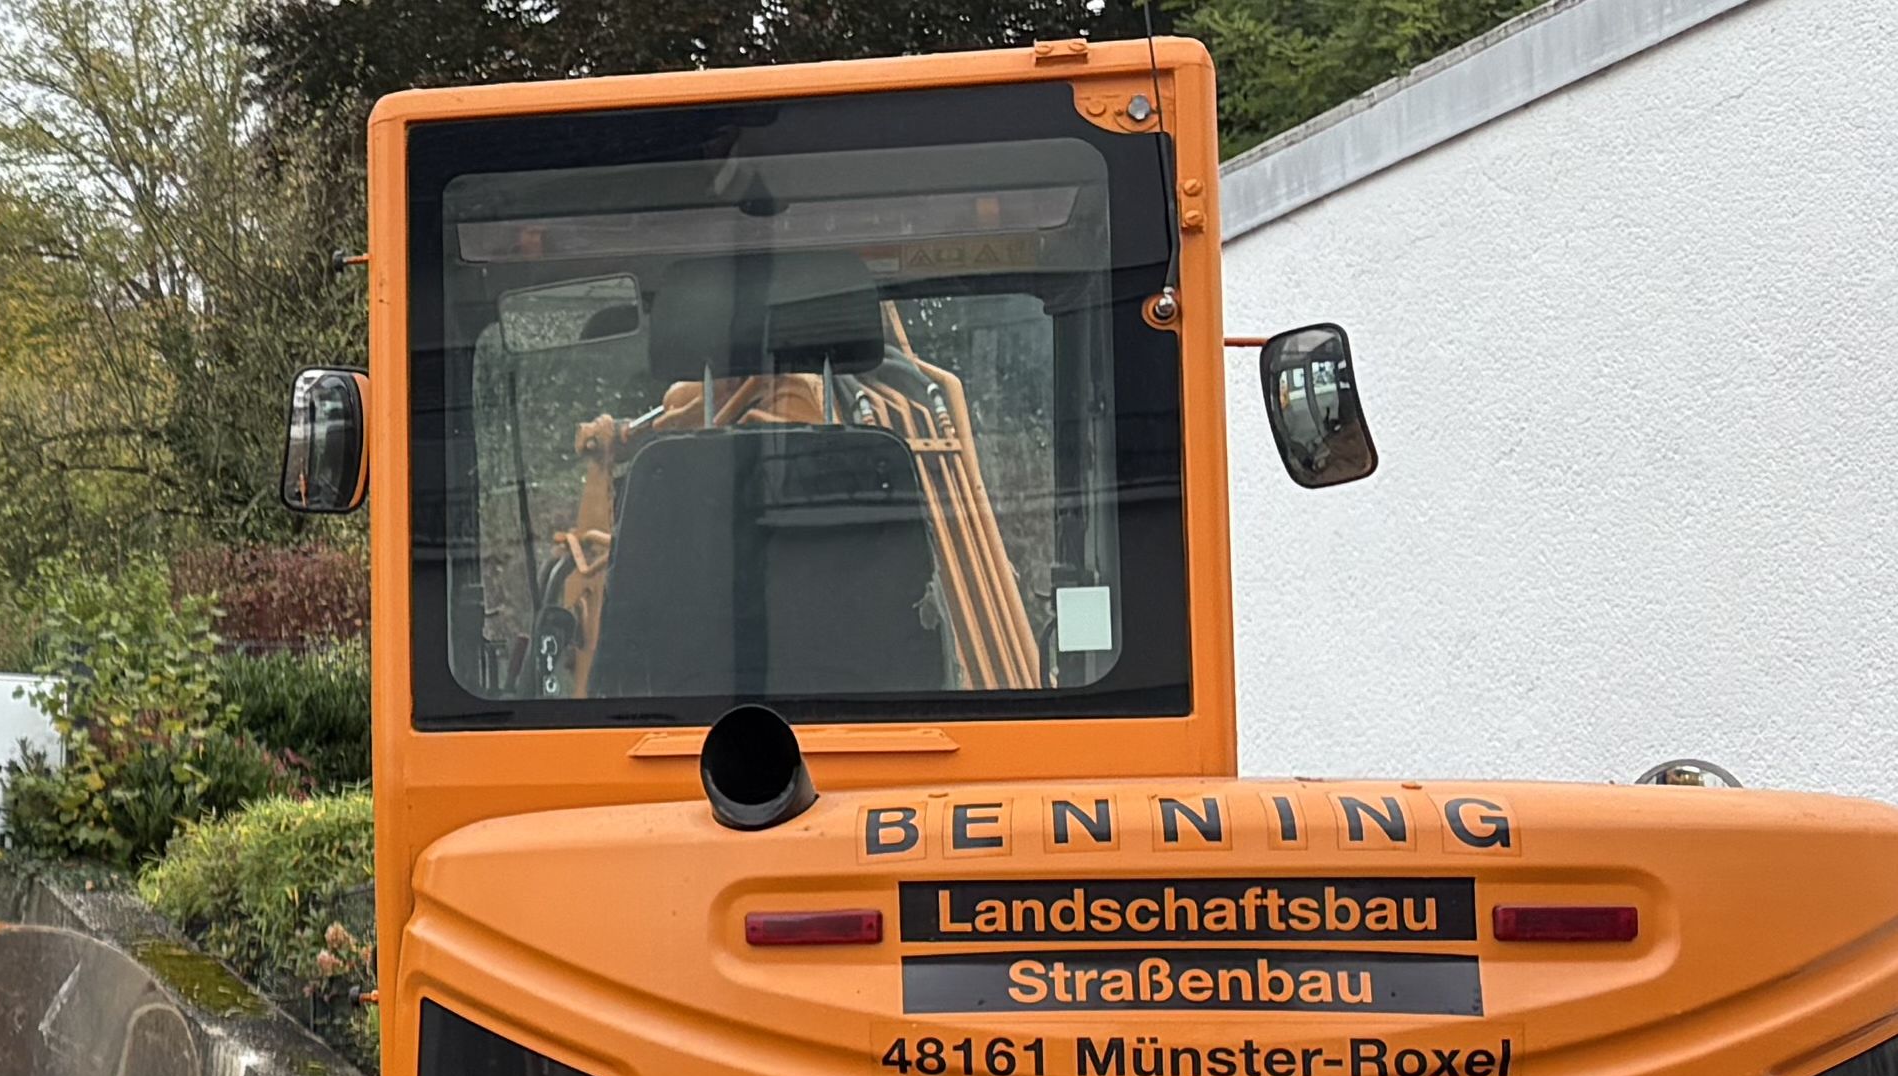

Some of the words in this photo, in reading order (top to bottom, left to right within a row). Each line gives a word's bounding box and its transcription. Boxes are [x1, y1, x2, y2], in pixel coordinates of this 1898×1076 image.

[864, 797, 1512, 856] BENNING
[938, 886, 1438, 934] Landschaftsbau
[1007, 959, 1374, 1005] Straßenbau
